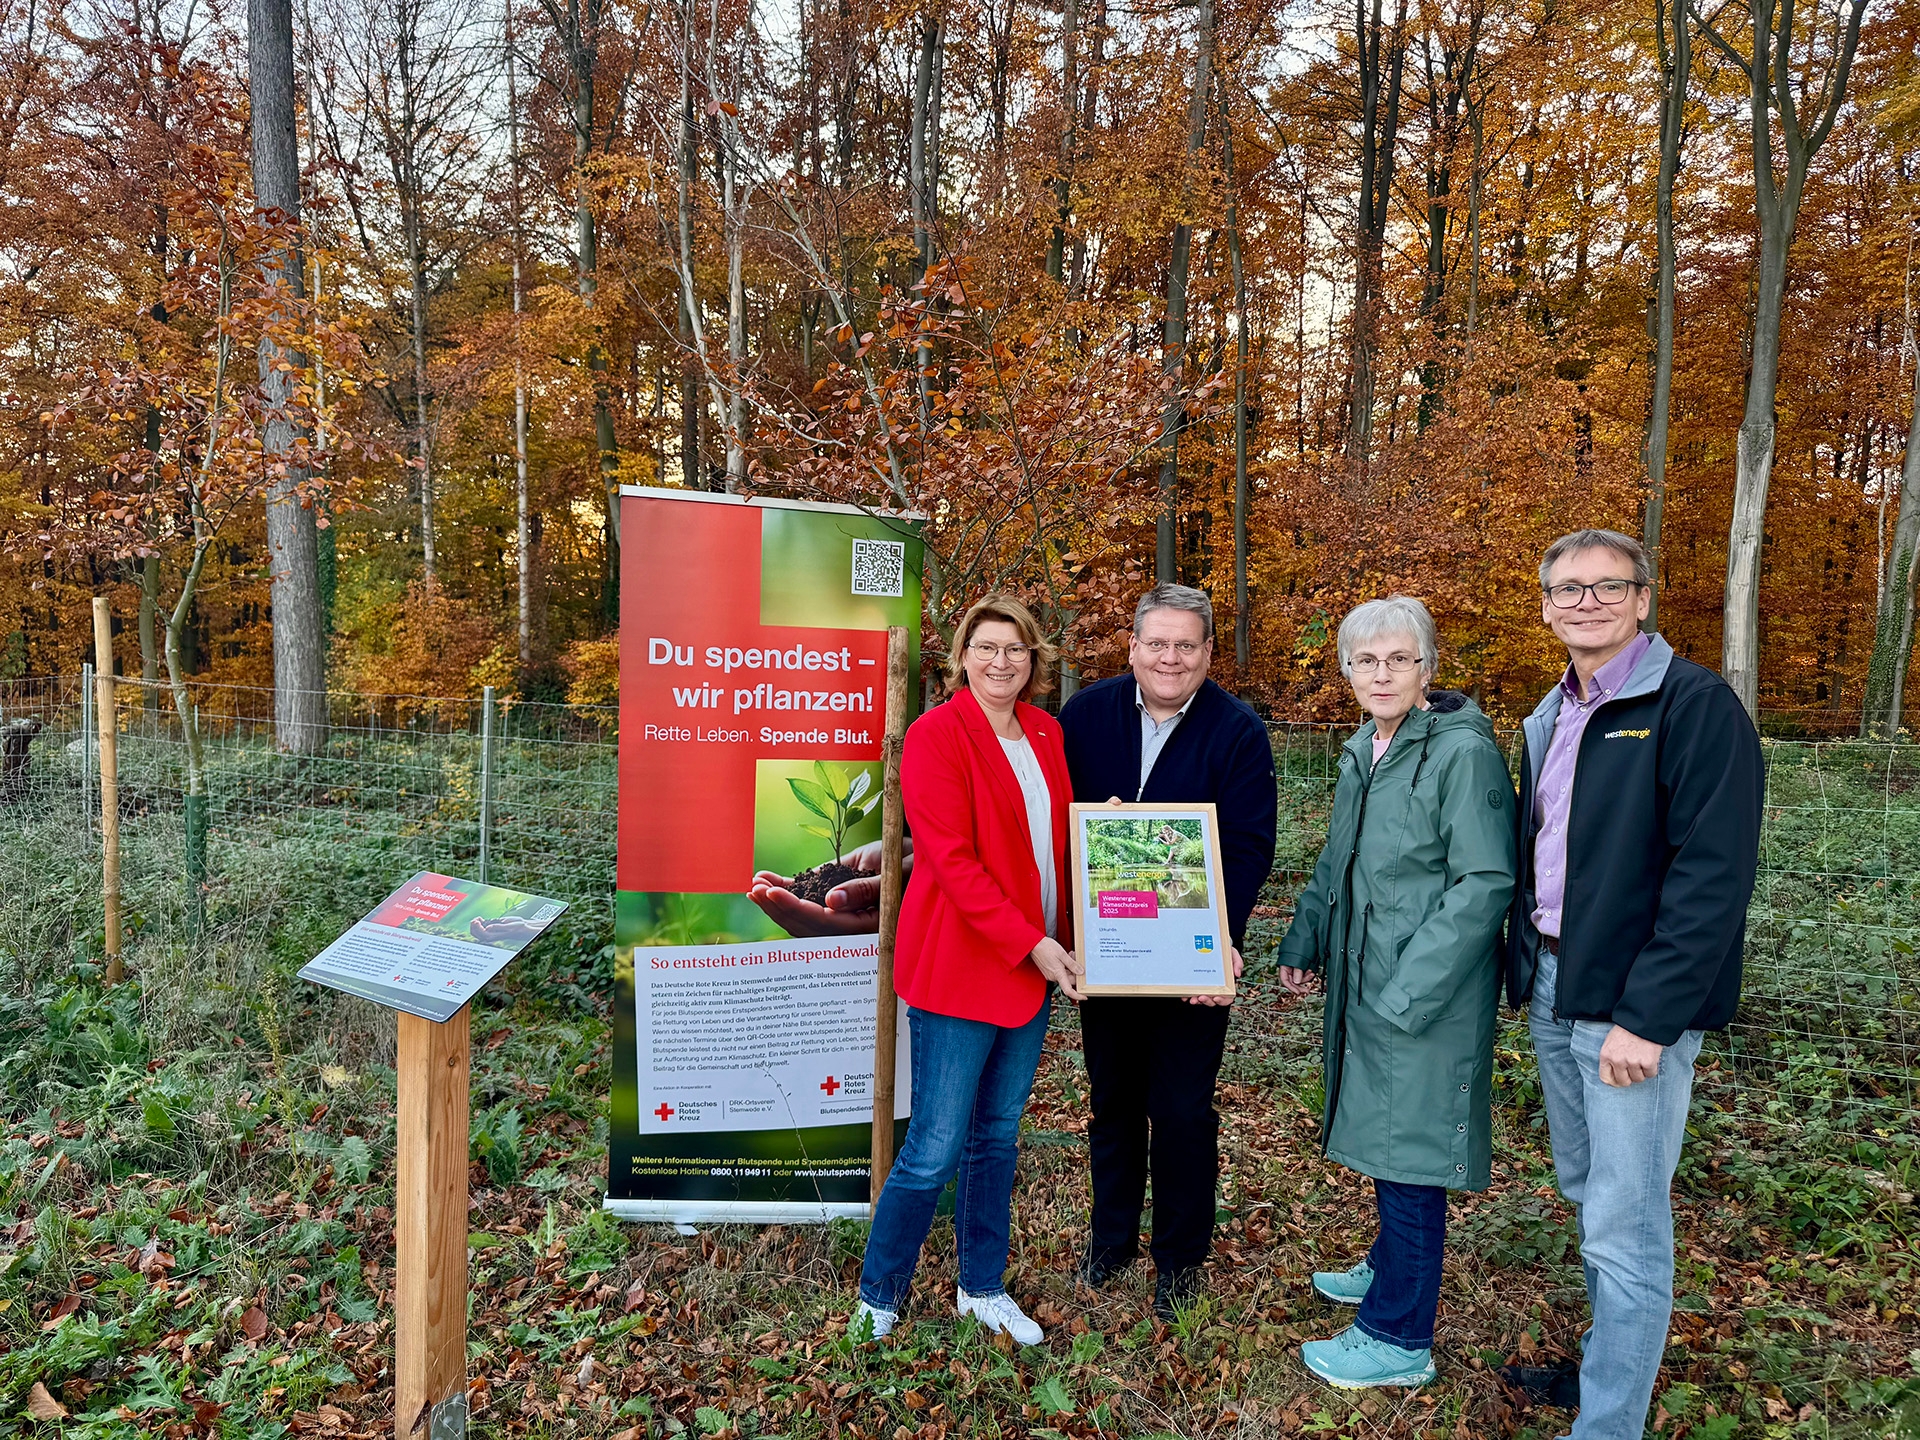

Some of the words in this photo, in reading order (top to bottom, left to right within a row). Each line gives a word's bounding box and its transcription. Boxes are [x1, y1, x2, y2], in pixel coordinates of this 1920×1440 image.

[649, 638, 694, 666] Du
[705, 644, 851, 673] spendest
[673, 682, 724, 708] wir
[734, 684, 873, 714] pflanzen!
[645, 724, 691, 741] Rette
[697, 726, 753, 743] Leben.
[760, 727, 828, 745] Spende
[834, 729, 872, 744] Blut.
[422, 890, 455, 902] spendest
[416, 900, 451, 911] pflanzen!
[651, 957, 669, 969] So
[673, 955, 736, 969] entsteht
[740, 953, 762, 966] ein
[740, 977, 773, 985] Stemwede
[799, 970, 871, 980] DRK-Blutspendedienst
[724, 986, 764, 995] nachhaltiges
[766, 984, 807, 993] Engagement,
[652, 999, 690, 1008] gleichzeitig
[724, 996, 764, 1005] Klimaschutz
[732, 1005, 772, 1014] Erstspenders
[746, 1012, 790, 1022] Verantwortung
[820, 1105, 874, 1114] Blutspendedienst
[738, 1158, 782, 1166] Blutspende
[632, 1167, 678, 1175] Kostenlose
